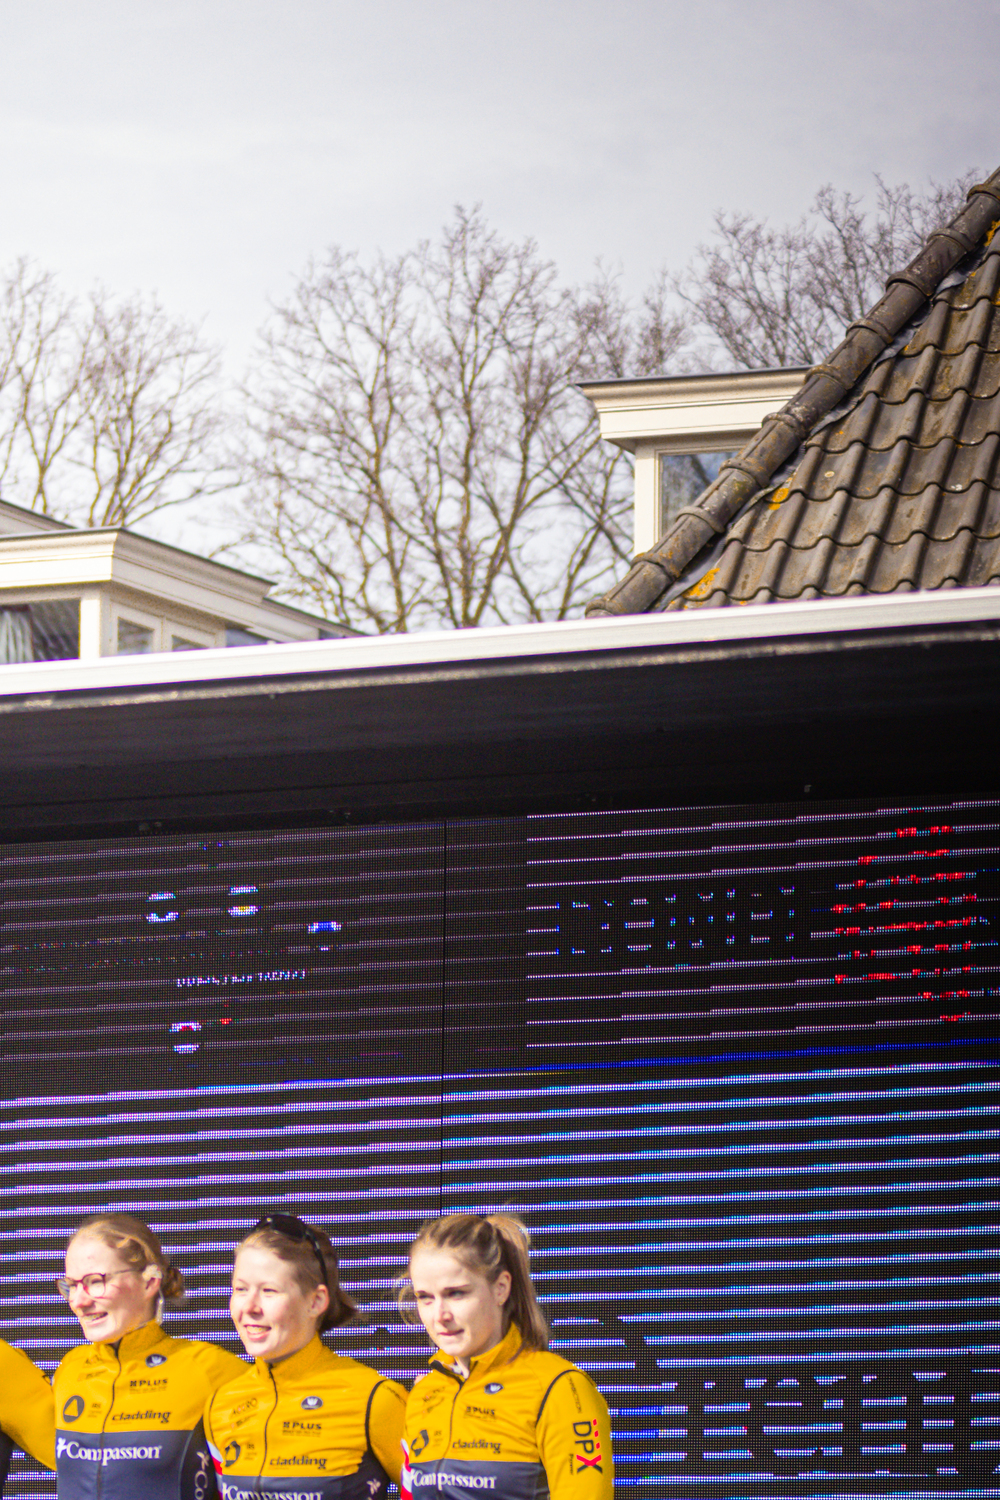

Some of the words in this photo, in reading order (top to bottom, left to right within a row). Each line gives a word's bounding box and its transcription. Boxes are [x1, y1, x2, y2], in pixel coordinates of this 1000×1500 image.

[112, 1410, 171, 1424] cladding
[66, 1441, 160, 1466] Compassion
[452, 1439, 501, 1454] cladding
[573, 1421, 603, 1475] DPX
[269, 1456, 327, 1469] cladding
[413, 1470, 496, 1491] Compassion
